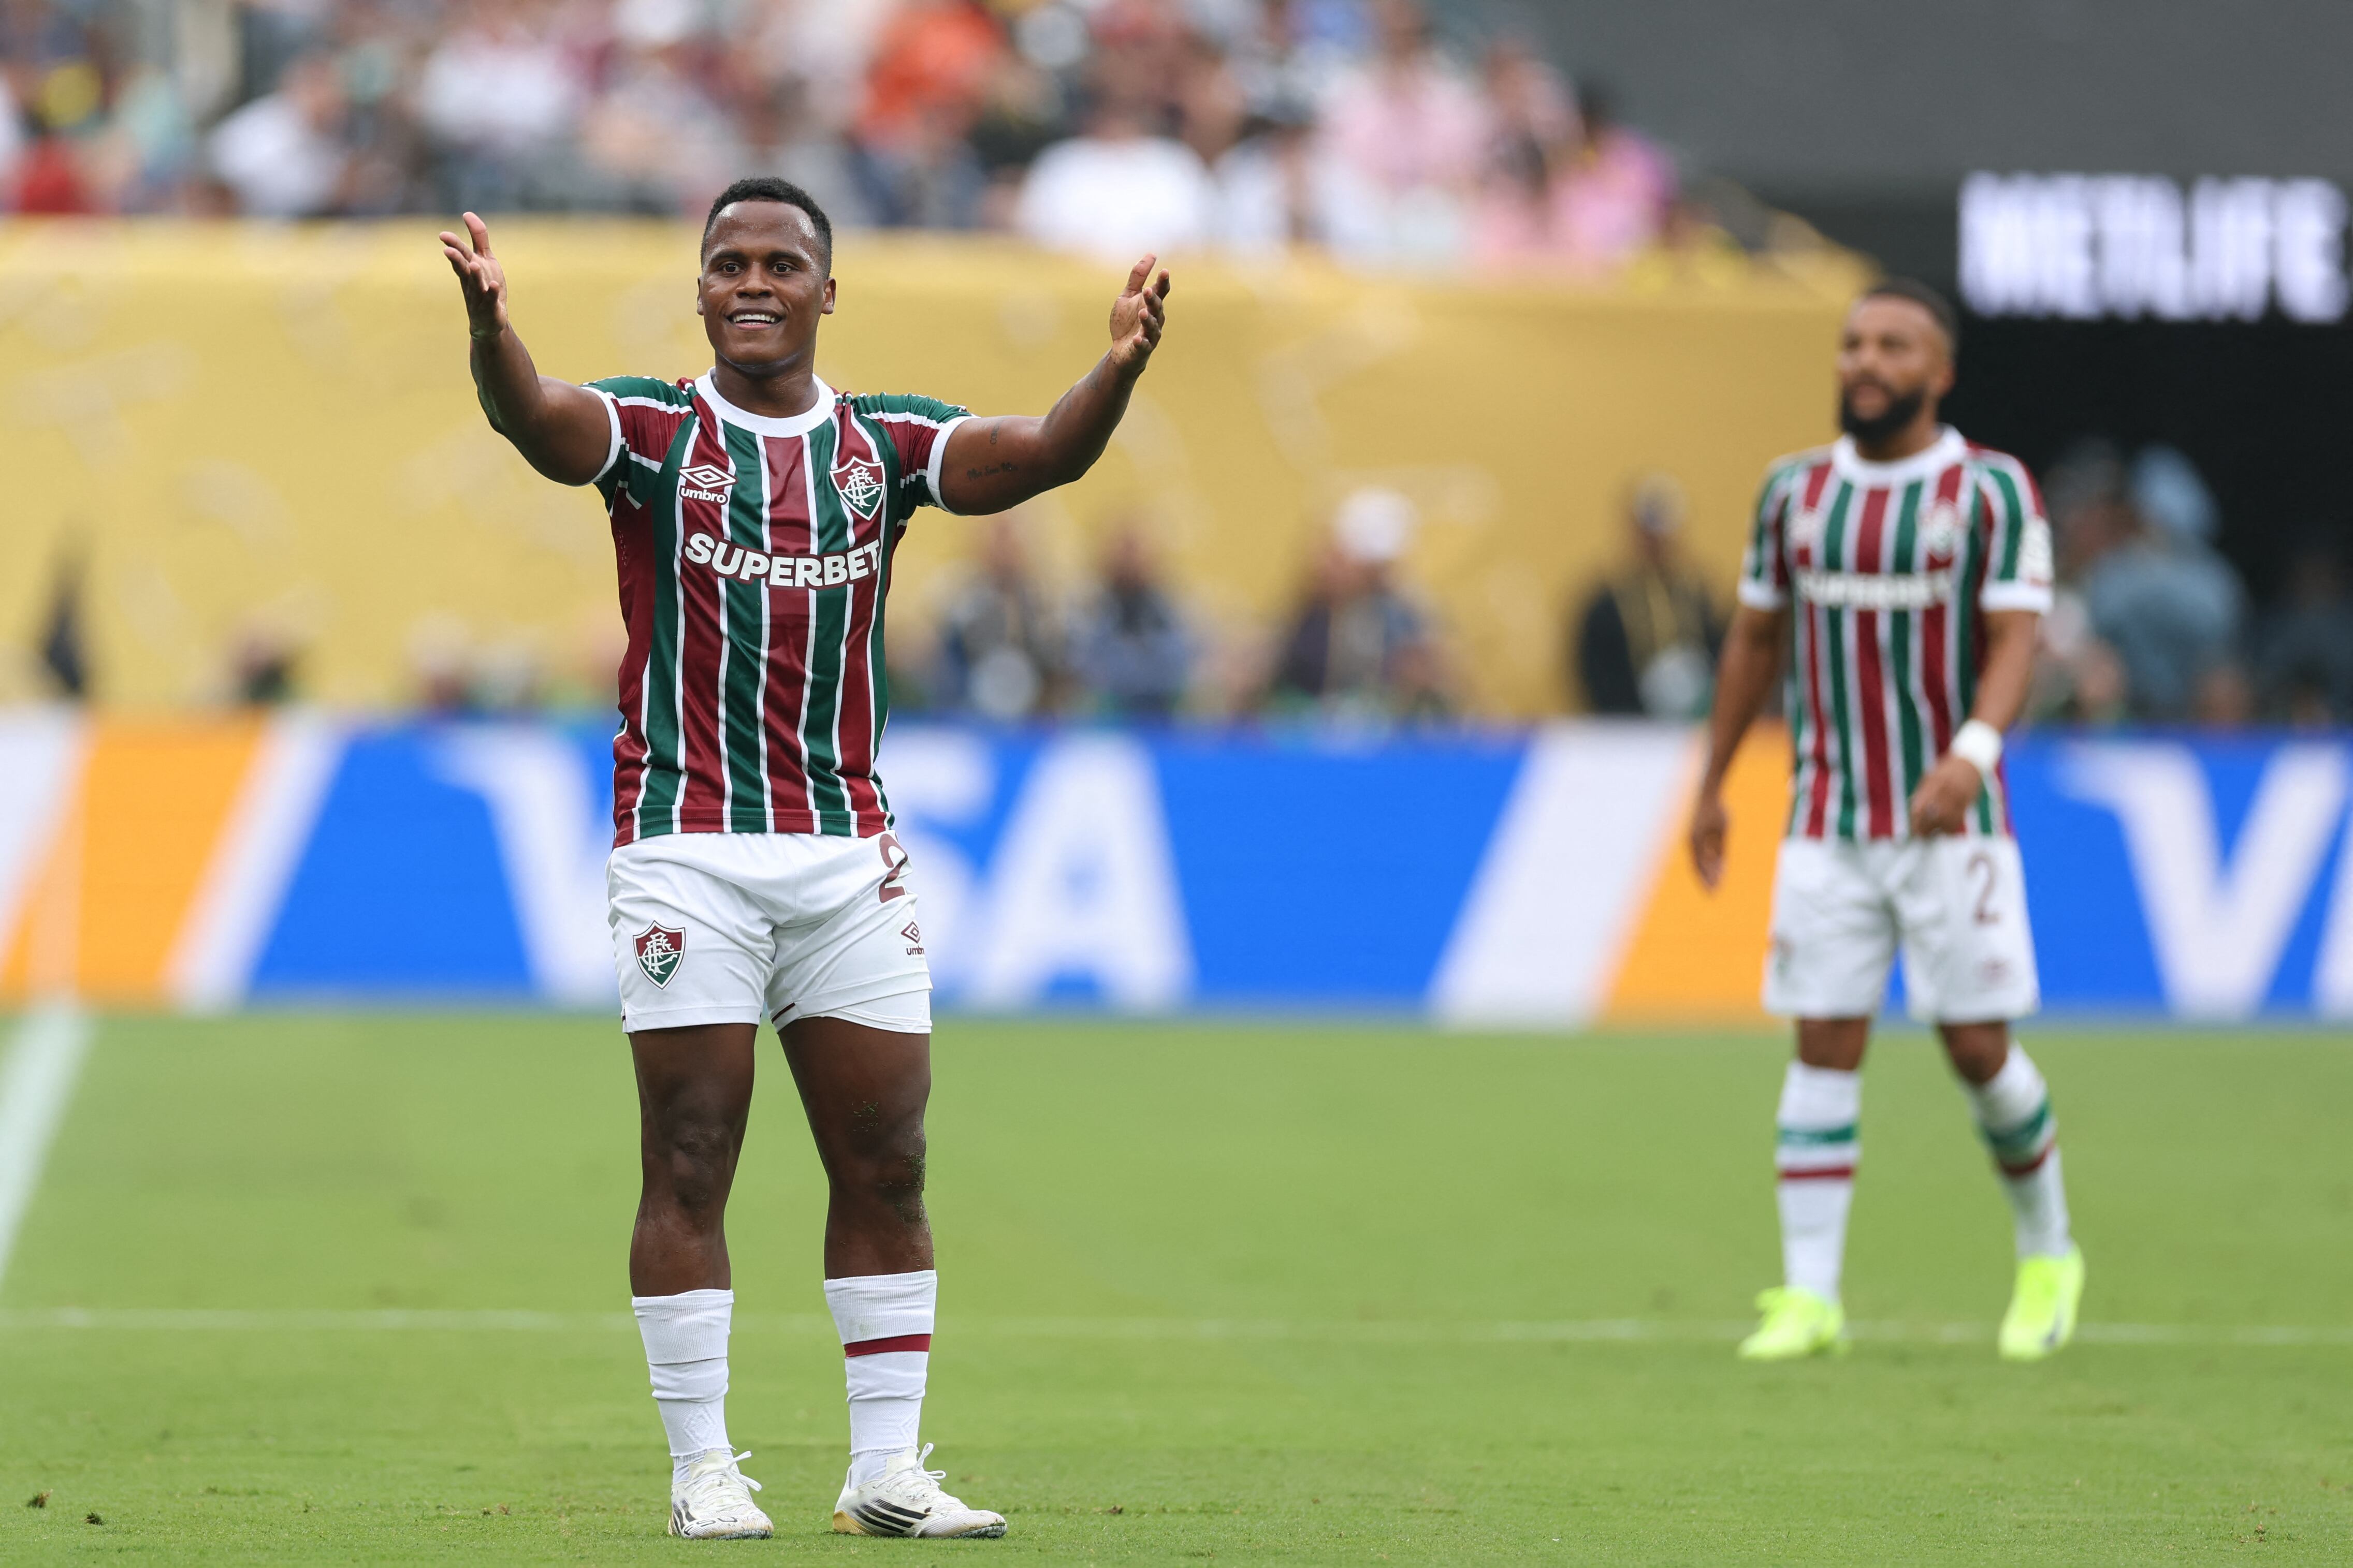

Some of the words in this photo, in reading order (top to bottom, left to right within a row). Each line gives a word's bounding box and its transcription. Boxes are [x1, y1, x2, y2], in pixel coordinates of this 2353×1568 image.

[1959, 172, 2348, 321] METLIFE
[680, 488, 727, 503] umbro
[685, 533, 879, 587] SUPERBET
[879, 832, 908, 903] 2
[1967, 852, 2001, 924] 2
